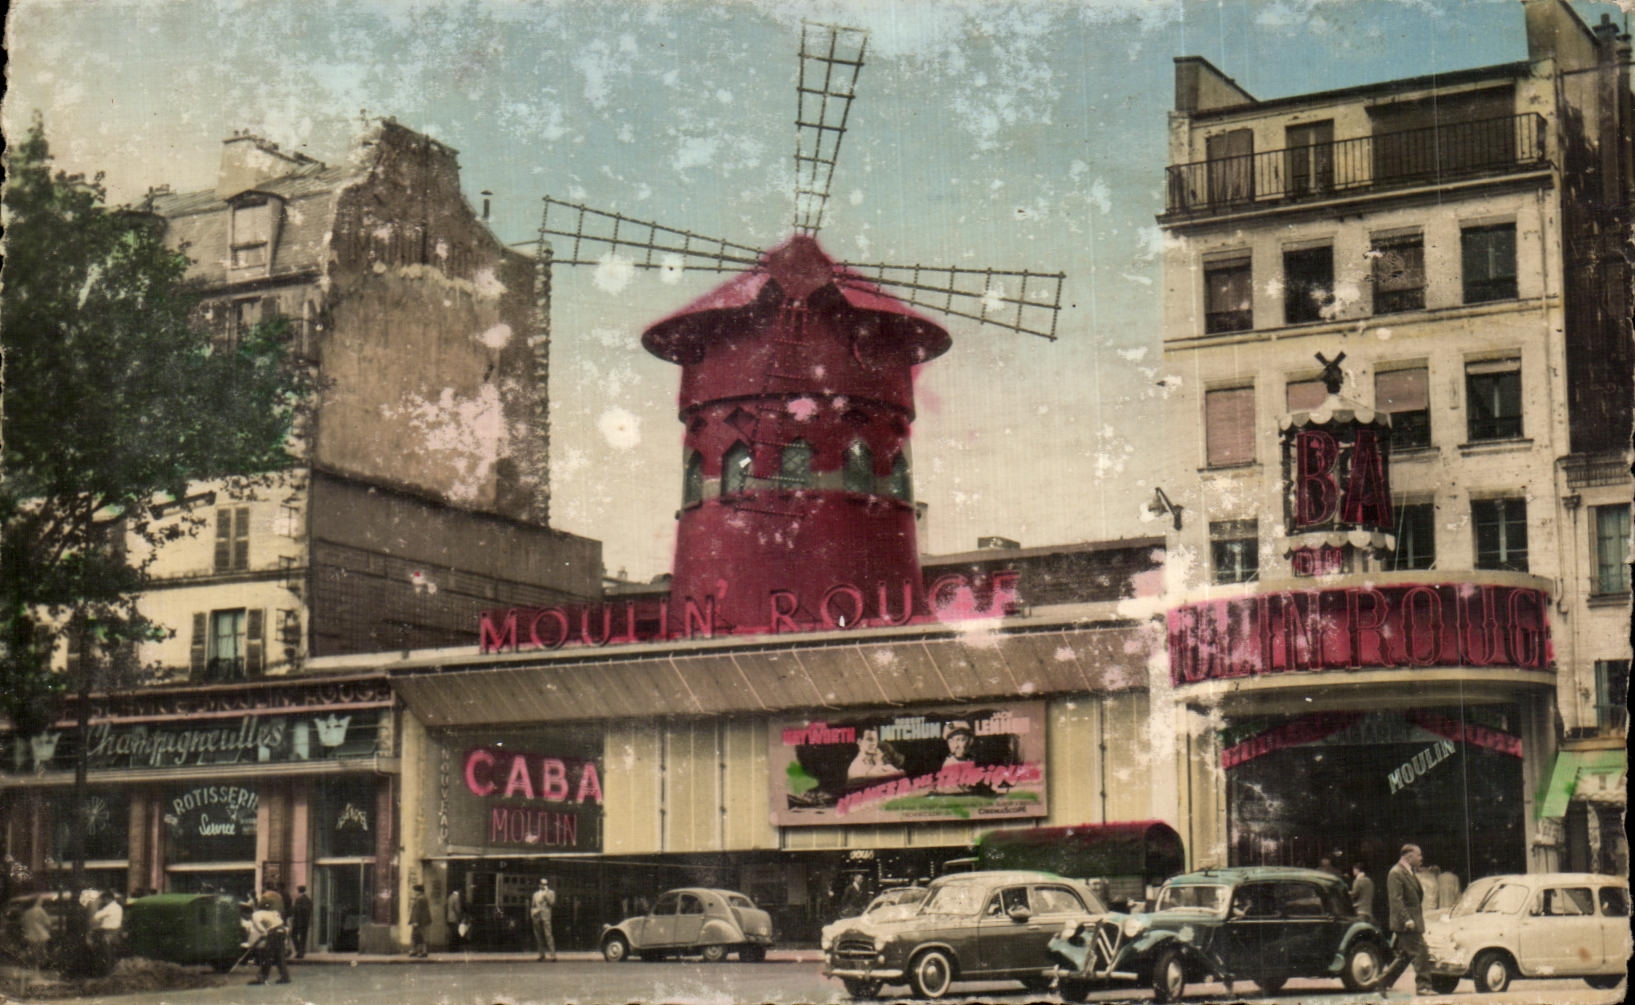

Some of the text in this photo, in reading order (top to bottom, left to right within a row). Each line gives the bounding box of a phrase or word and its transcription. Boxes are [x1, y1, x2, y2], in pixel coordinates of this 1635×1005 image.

[478, 570, 1021, 656] MOULIN ROUGE
[465, 749, 604, 804] CABA
[1387, 740, 1456, 795] MOULIN
[491, 807, 577, 847] MOULIN
